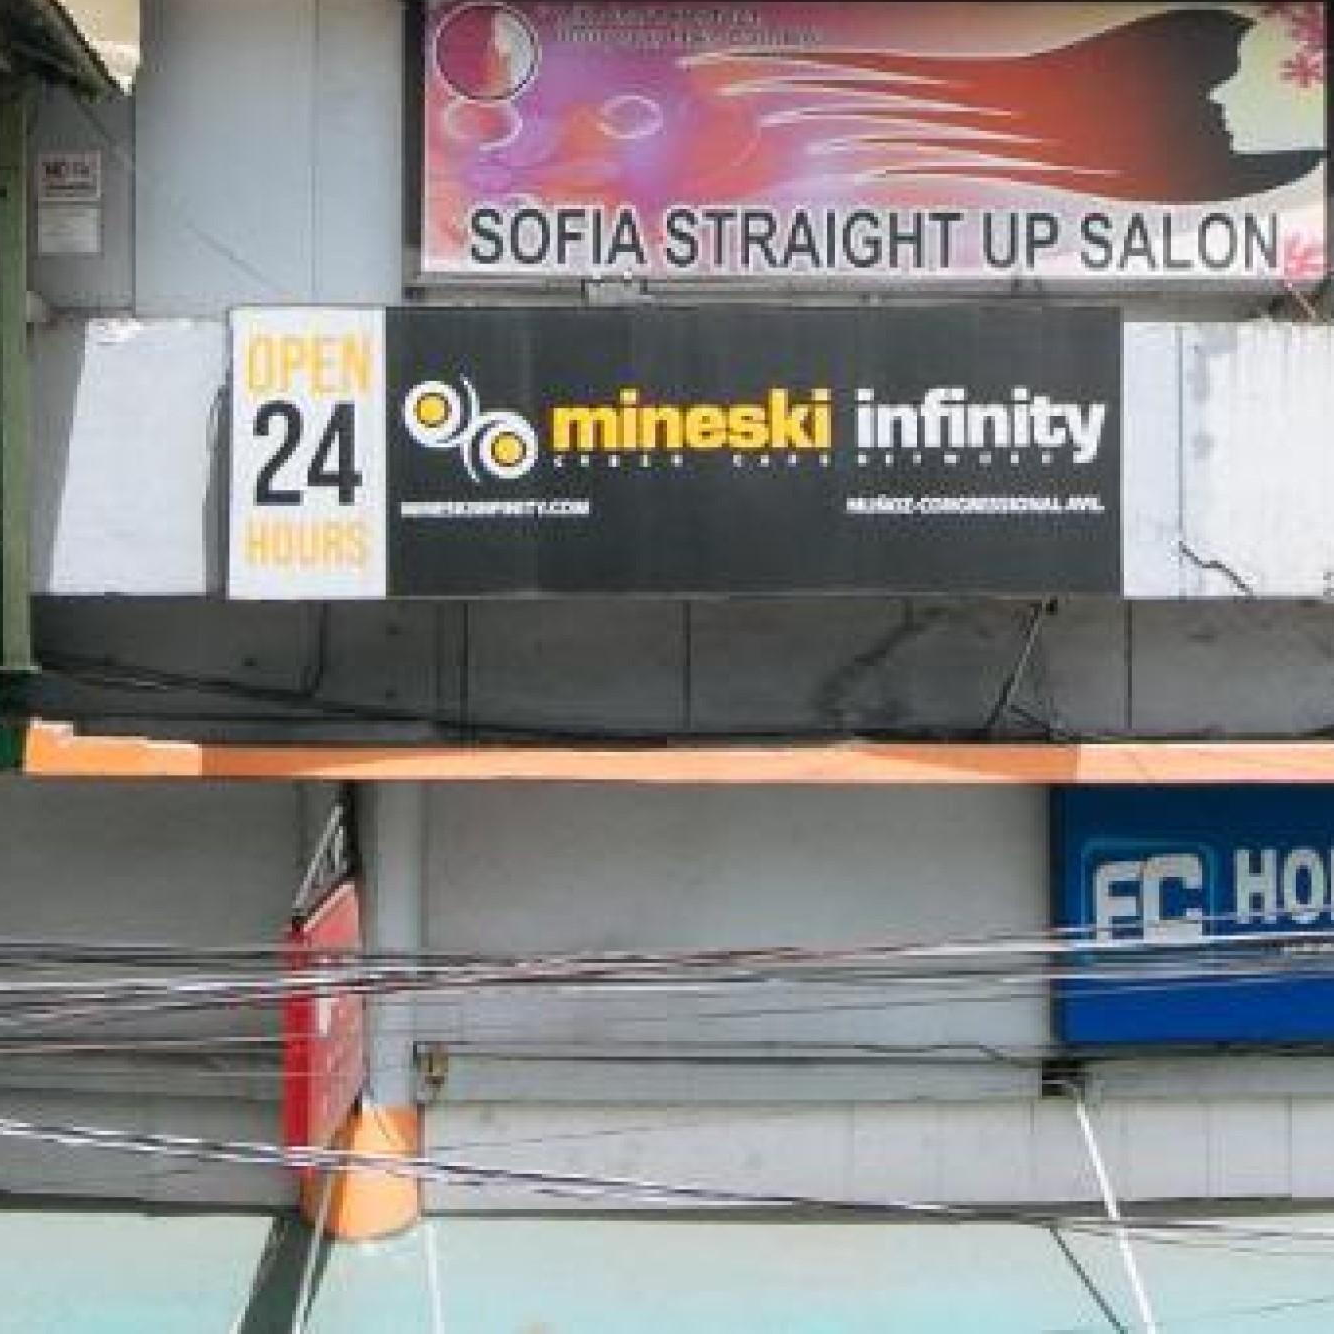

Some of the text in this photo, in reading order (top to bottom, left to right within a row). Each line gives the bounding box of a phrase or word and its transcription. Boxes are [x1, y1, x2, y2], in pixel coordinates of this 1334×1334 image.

[469, 207, 1279, 270] SOFIA STRAIGHT UP SALON
[246, 333, 371, 396] OPEN
[251, 399, 363, 507] 24
[551, 386, 1106, 466] mineski infinity
[247, 523, 370, 571] HOURS
